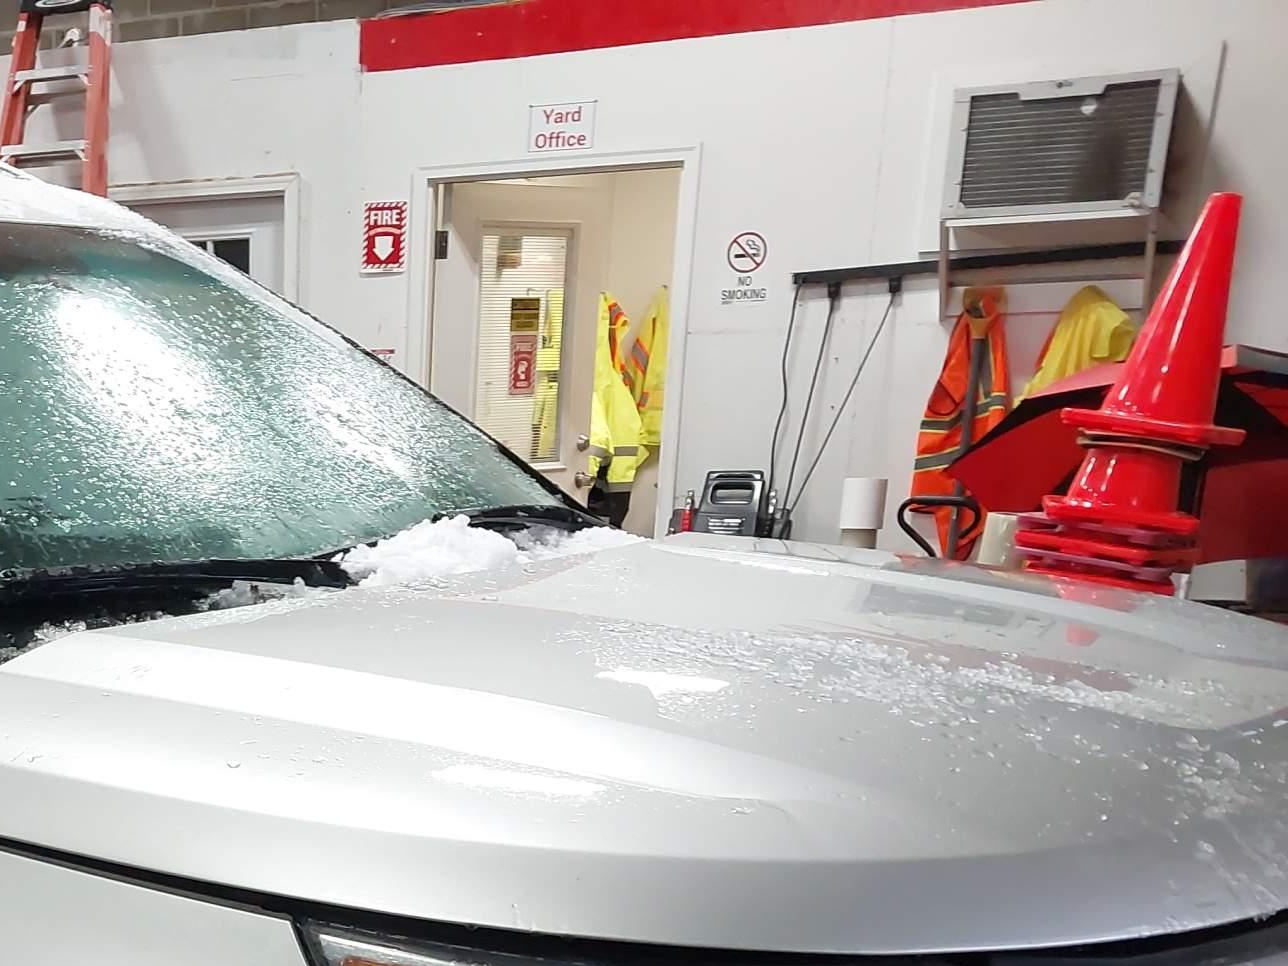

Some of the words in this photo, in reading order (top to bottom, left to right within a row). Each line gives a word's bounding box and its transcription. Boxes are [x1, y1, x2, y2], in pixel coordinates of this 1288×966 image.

[543, 106, 582, 125] Yard
[535, 131, 587, 149] Office
[369, 209, 401, 225] FIRE
[737, 276, 752, 287] NO
[721, 288, 767, 301] SMOKING
